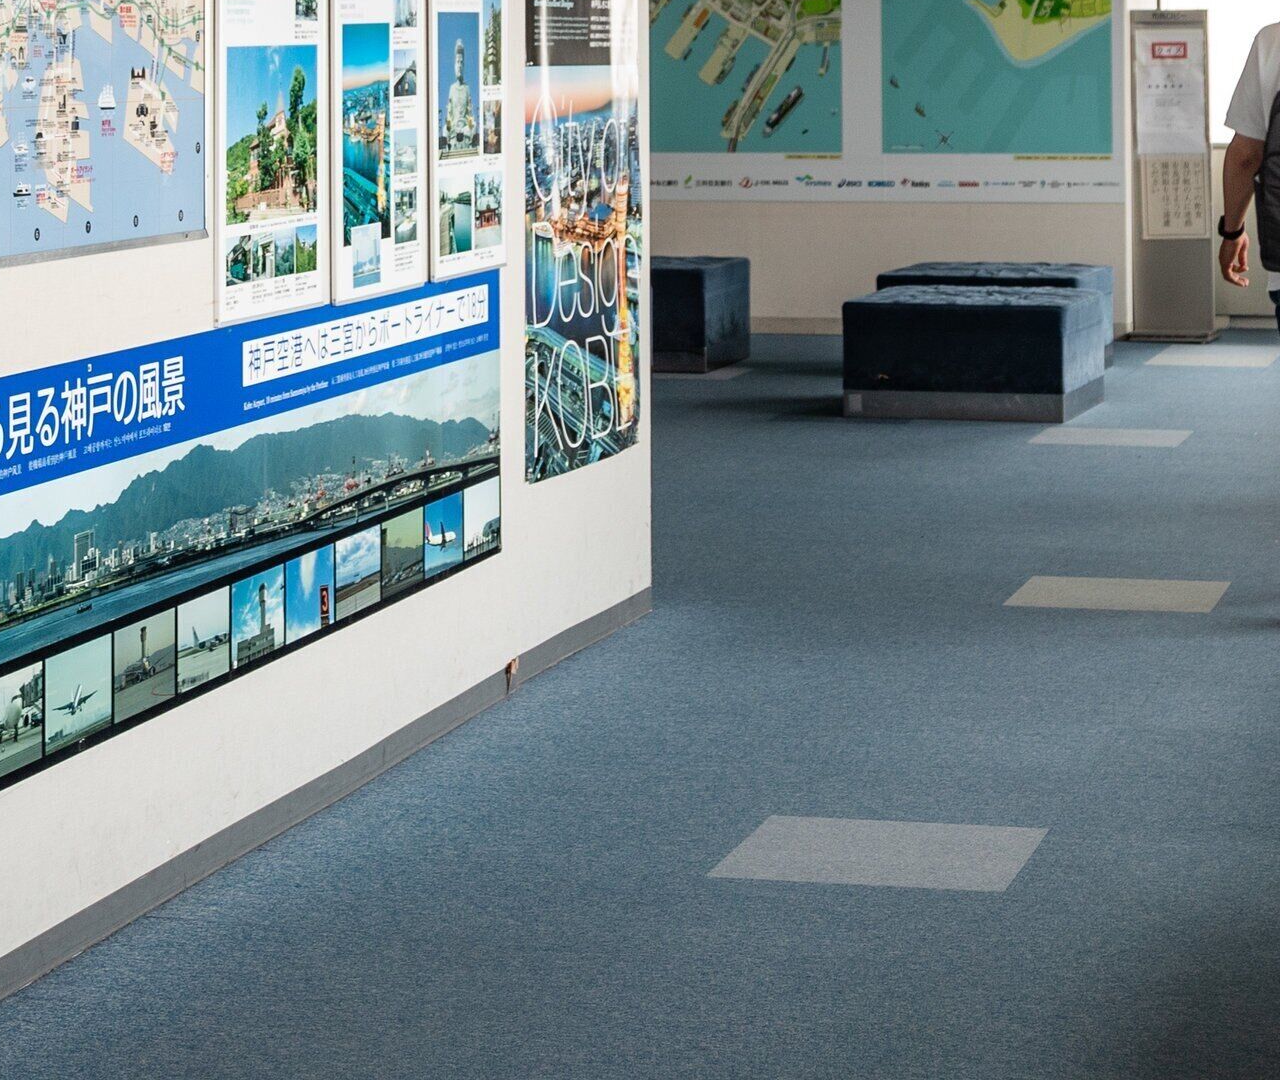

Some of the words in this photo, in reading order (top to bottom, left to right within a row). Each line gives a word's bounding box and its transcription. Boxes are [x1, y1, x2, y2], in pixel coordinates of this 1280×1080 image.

[248, 288, 488, 381] 神戸空港へは三宮からポートライナーで18分
[532, 221, 640, 337] Design
[533, 333, 633, 459] KOBE
